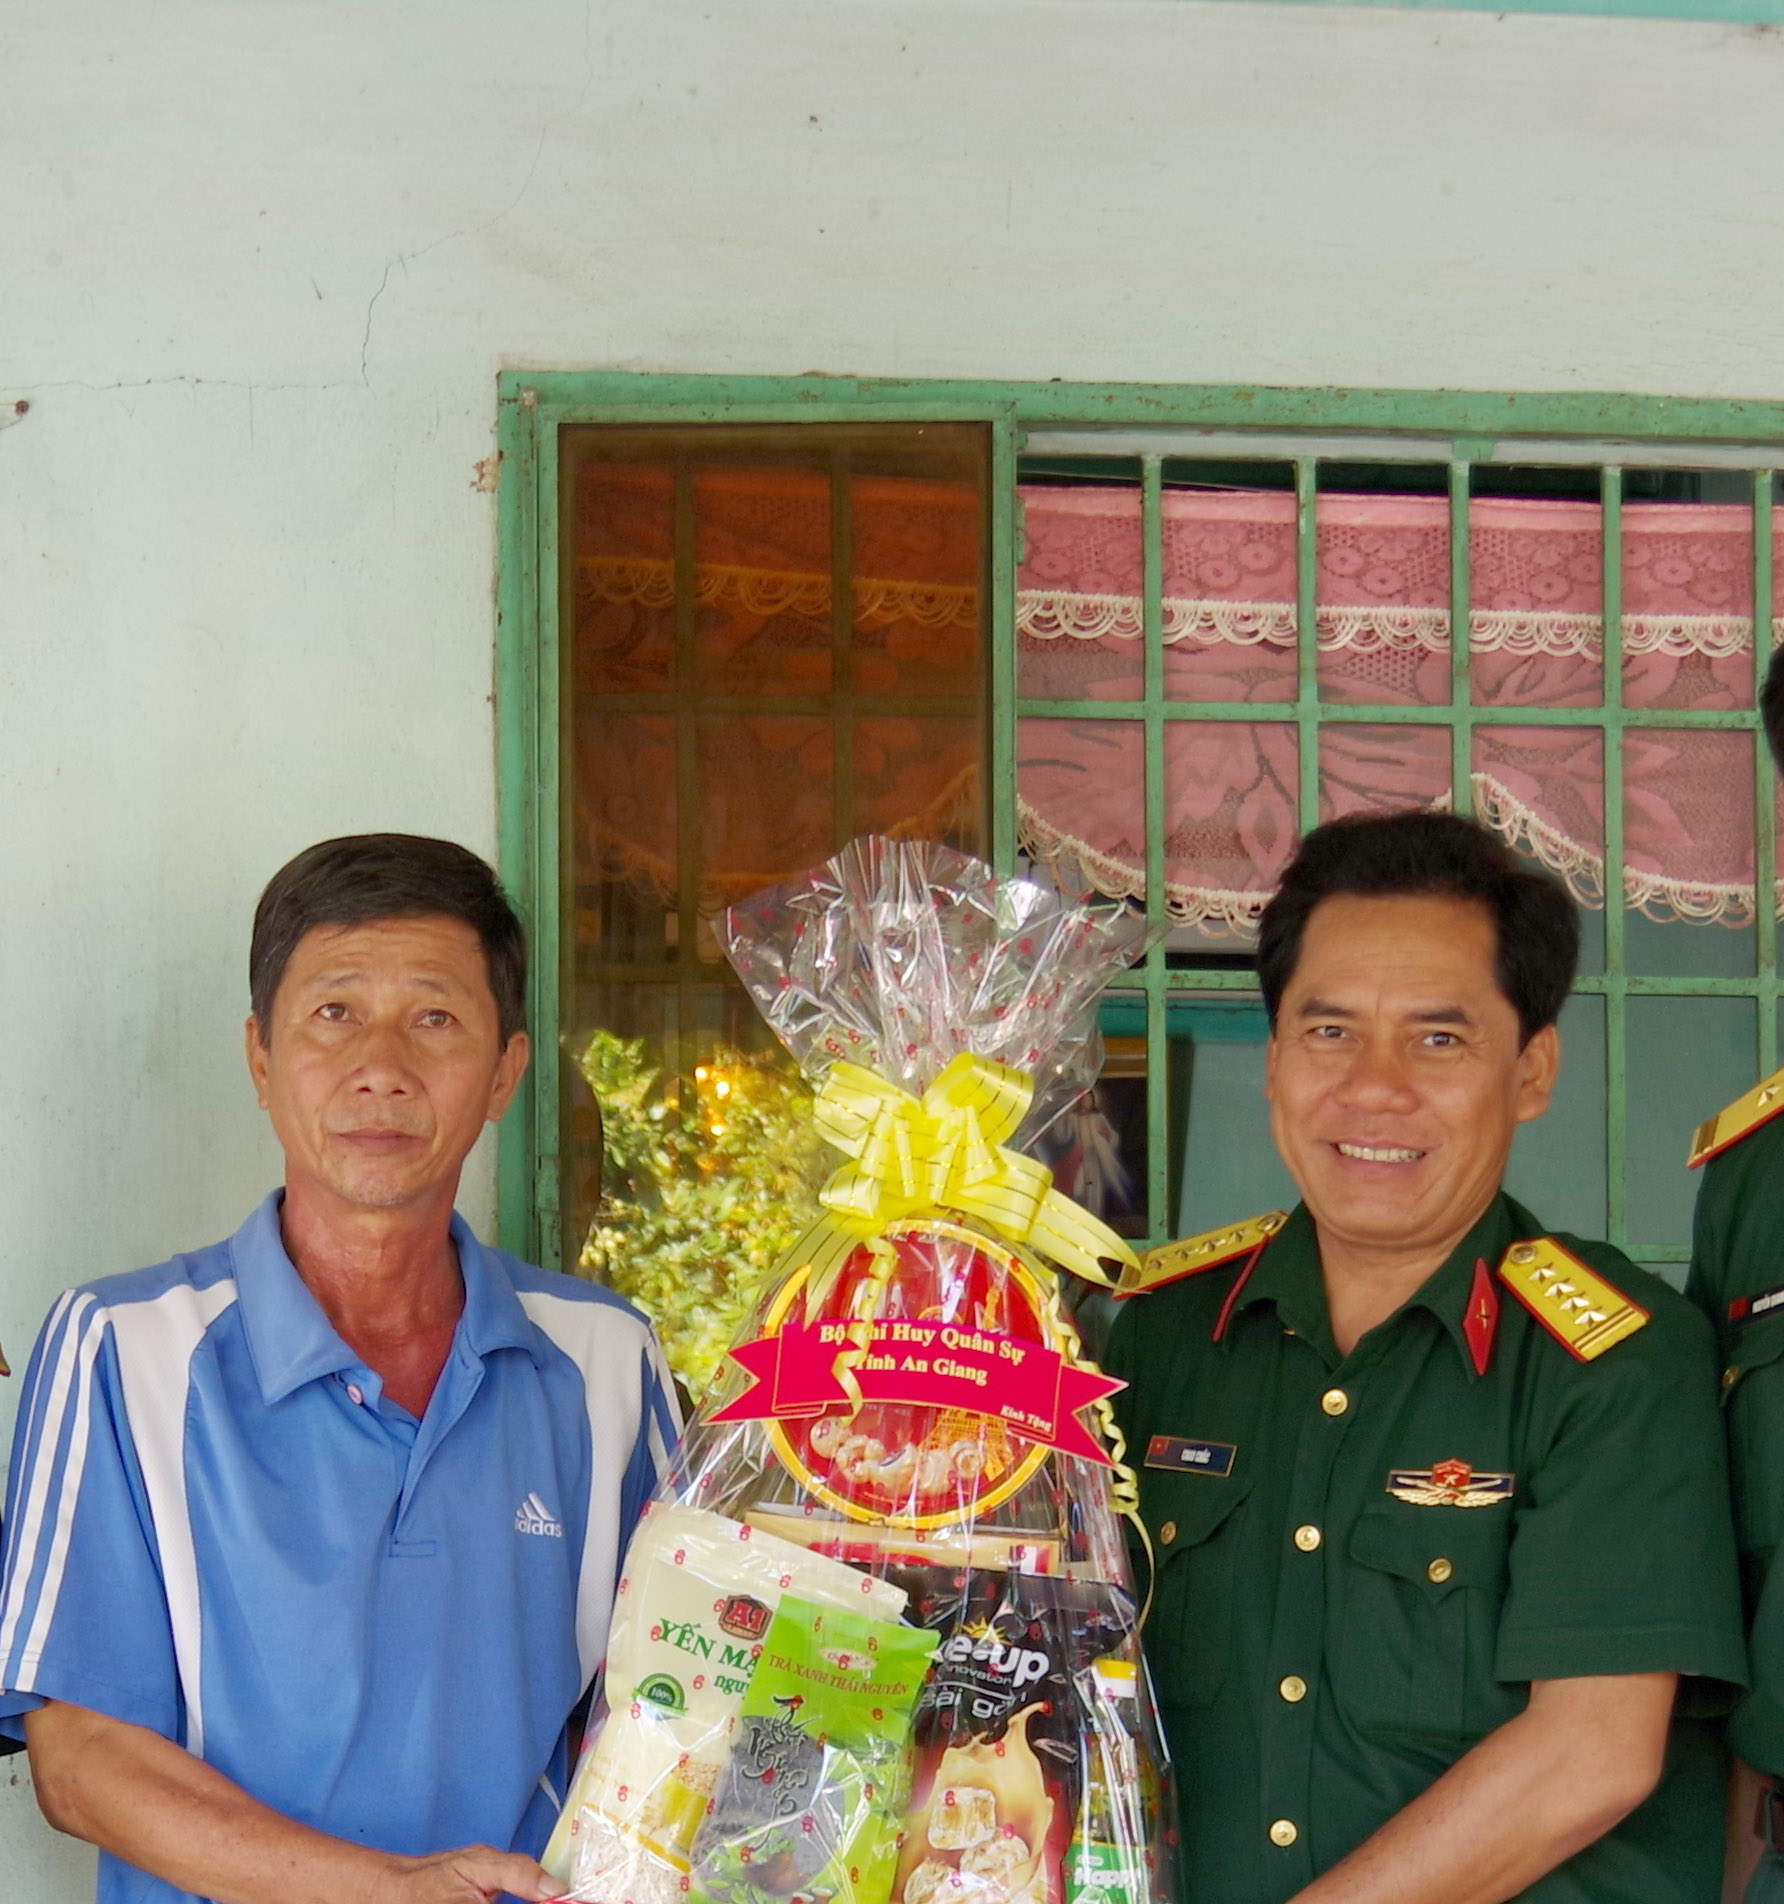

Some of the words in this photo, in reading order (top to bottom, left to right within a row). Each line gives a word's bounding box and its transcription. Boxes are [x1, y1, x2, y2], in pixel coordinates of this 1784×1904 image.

[819, 1324, 846, 1346] Bộ
[892, 1323, 936, 1347] Huy
[940, 1326, 995, 1355] Quân
[999, 1341, 1026, 1366] Sự
[900, 1355, 928, 1373] An
[933, 1357, 988, 1386] Giang
[725, 1600, 766, 1632] A1
[658, 1617, 716, 1661] YẾN
[718, 1643, 760, 1678] MẠ
[793, 1663, 829, 1684] XANH
[1073, 1867, 1138, 1889] Happ
